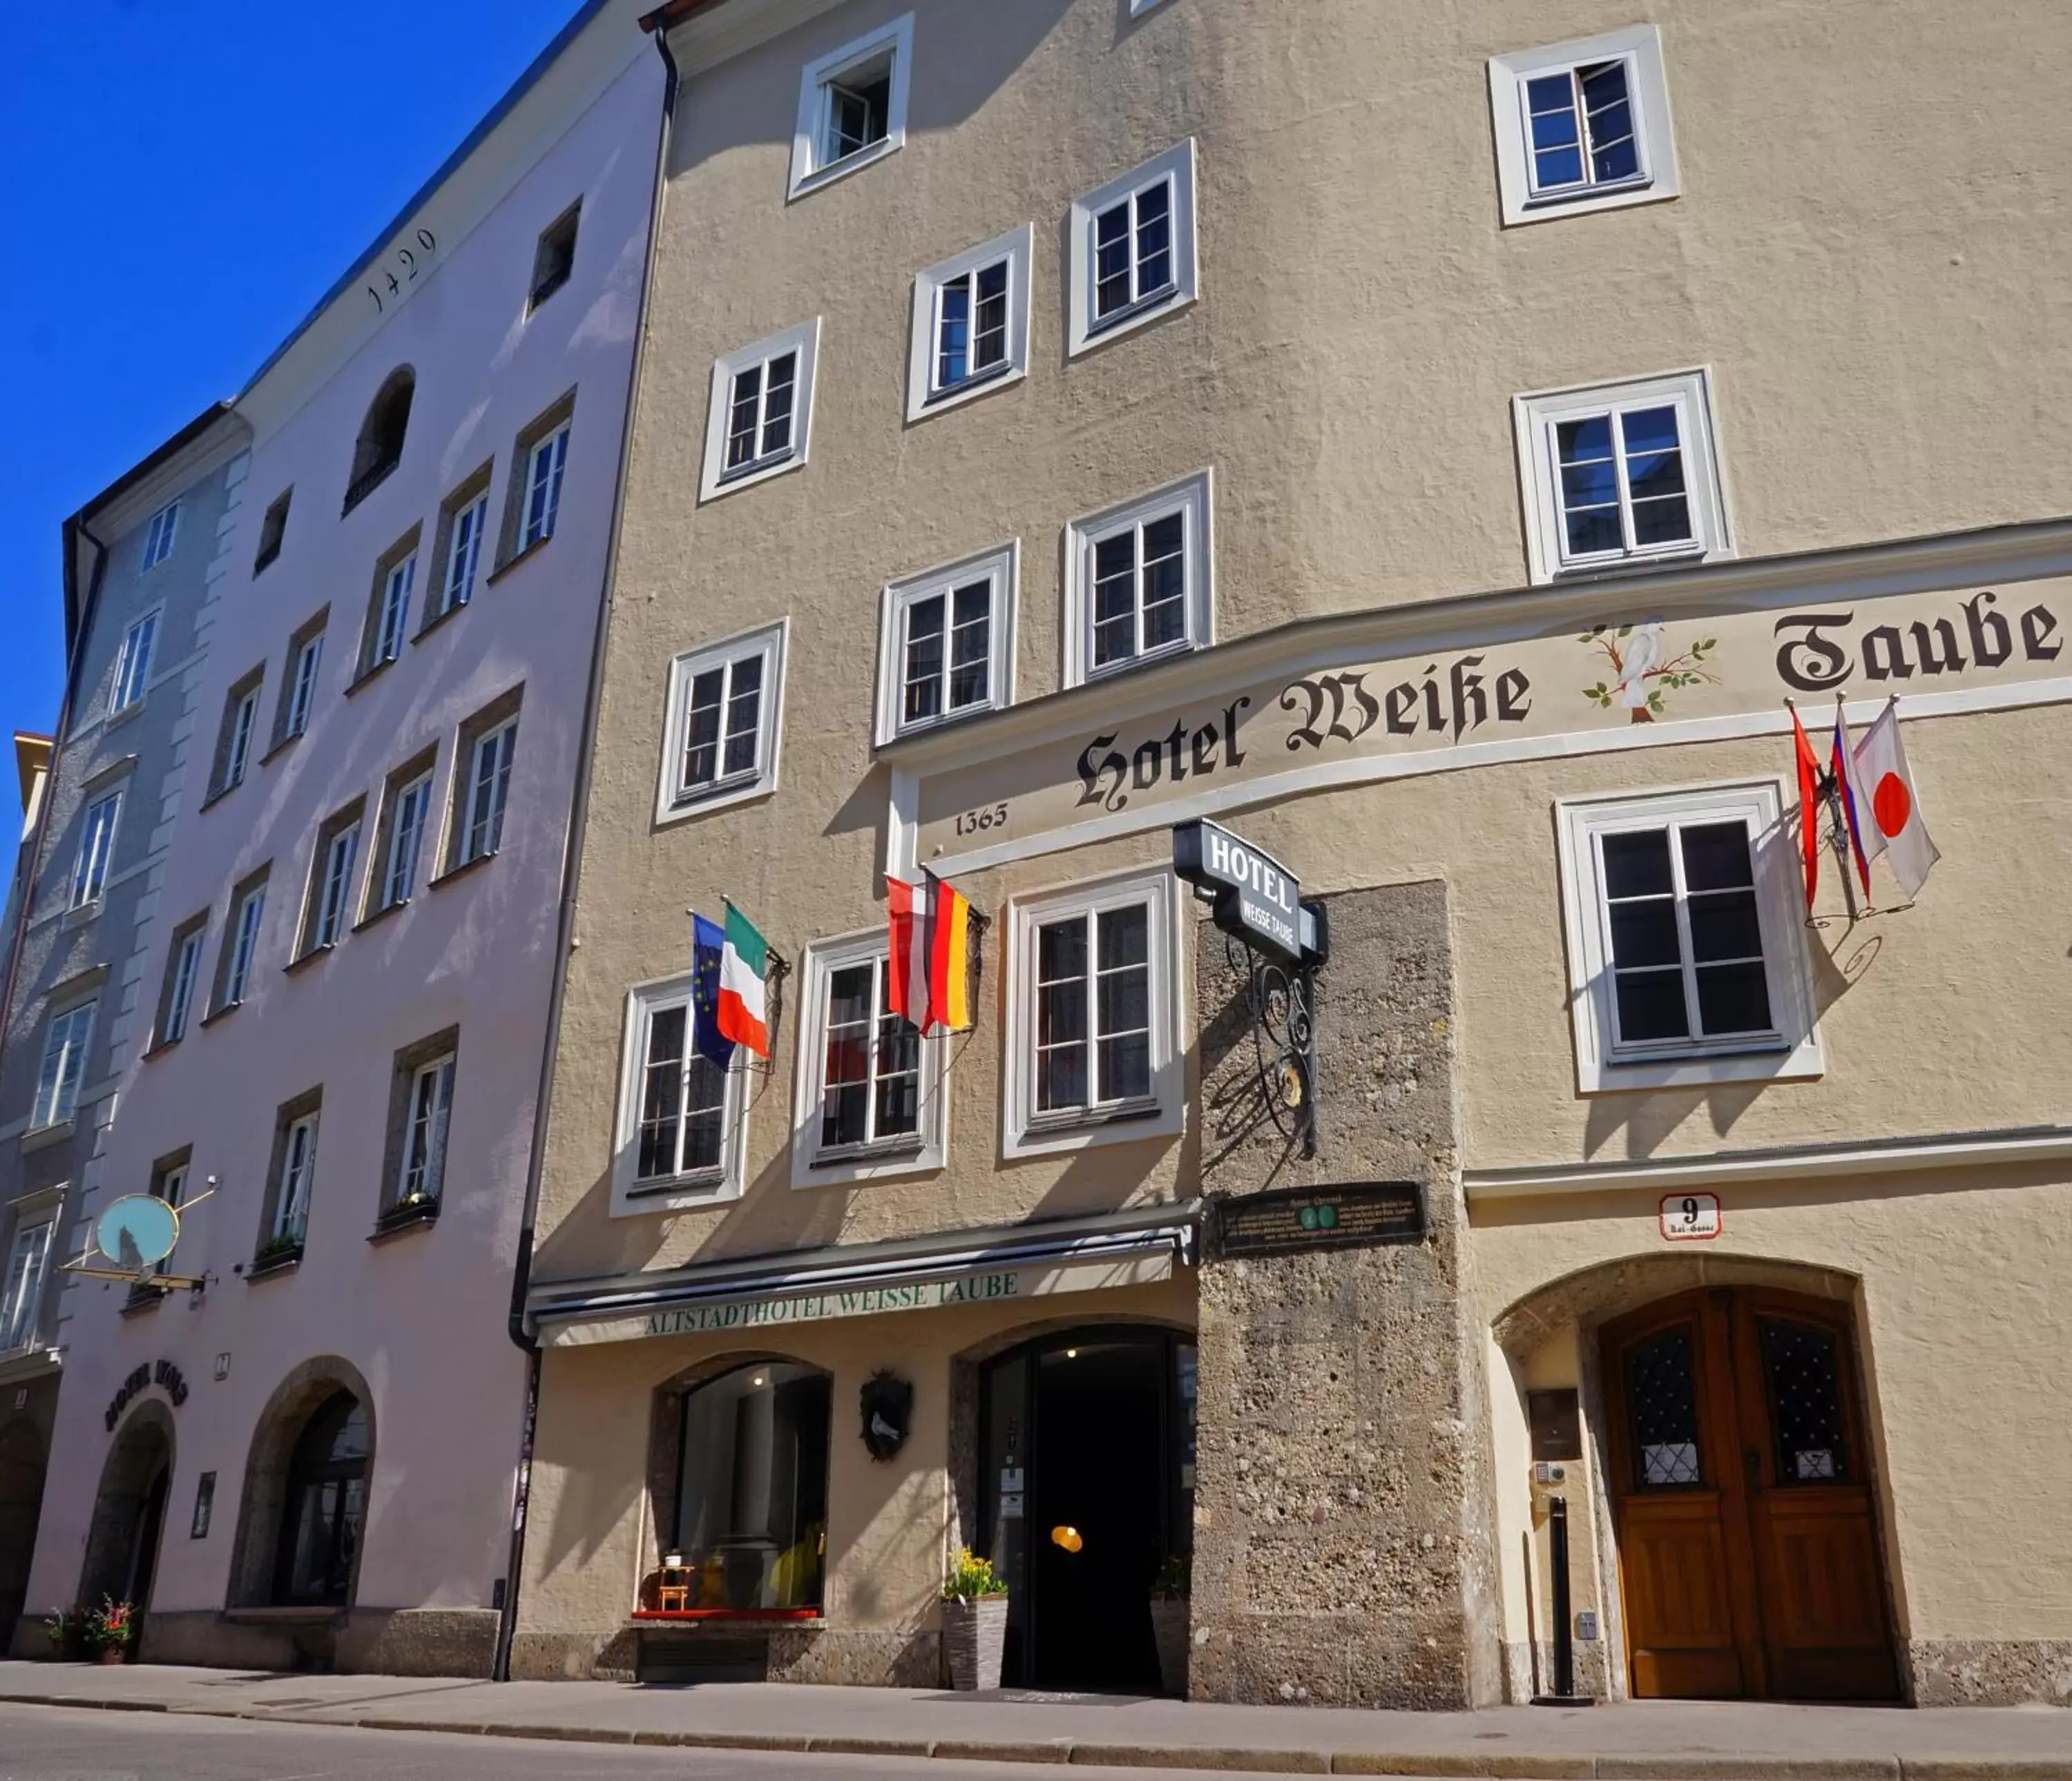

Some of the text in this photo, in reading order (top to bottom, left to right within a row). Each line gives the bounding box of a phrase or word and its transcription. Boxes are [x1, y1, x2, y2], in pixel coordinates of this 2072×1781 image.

[1076, 591, 2064, 812] Hotel Weiße Taube
[955, 803, 1008, 836] 1365
[1211, 835, 1293, 914] HOTEL
[1243, 899, 1294, 945] WEISSE TAUBE
[1682, 1197, 1698, 1223] 9
[644, 1273, 1019, 1335] ALTSTADTHOTEL WEISSE TAUBE
